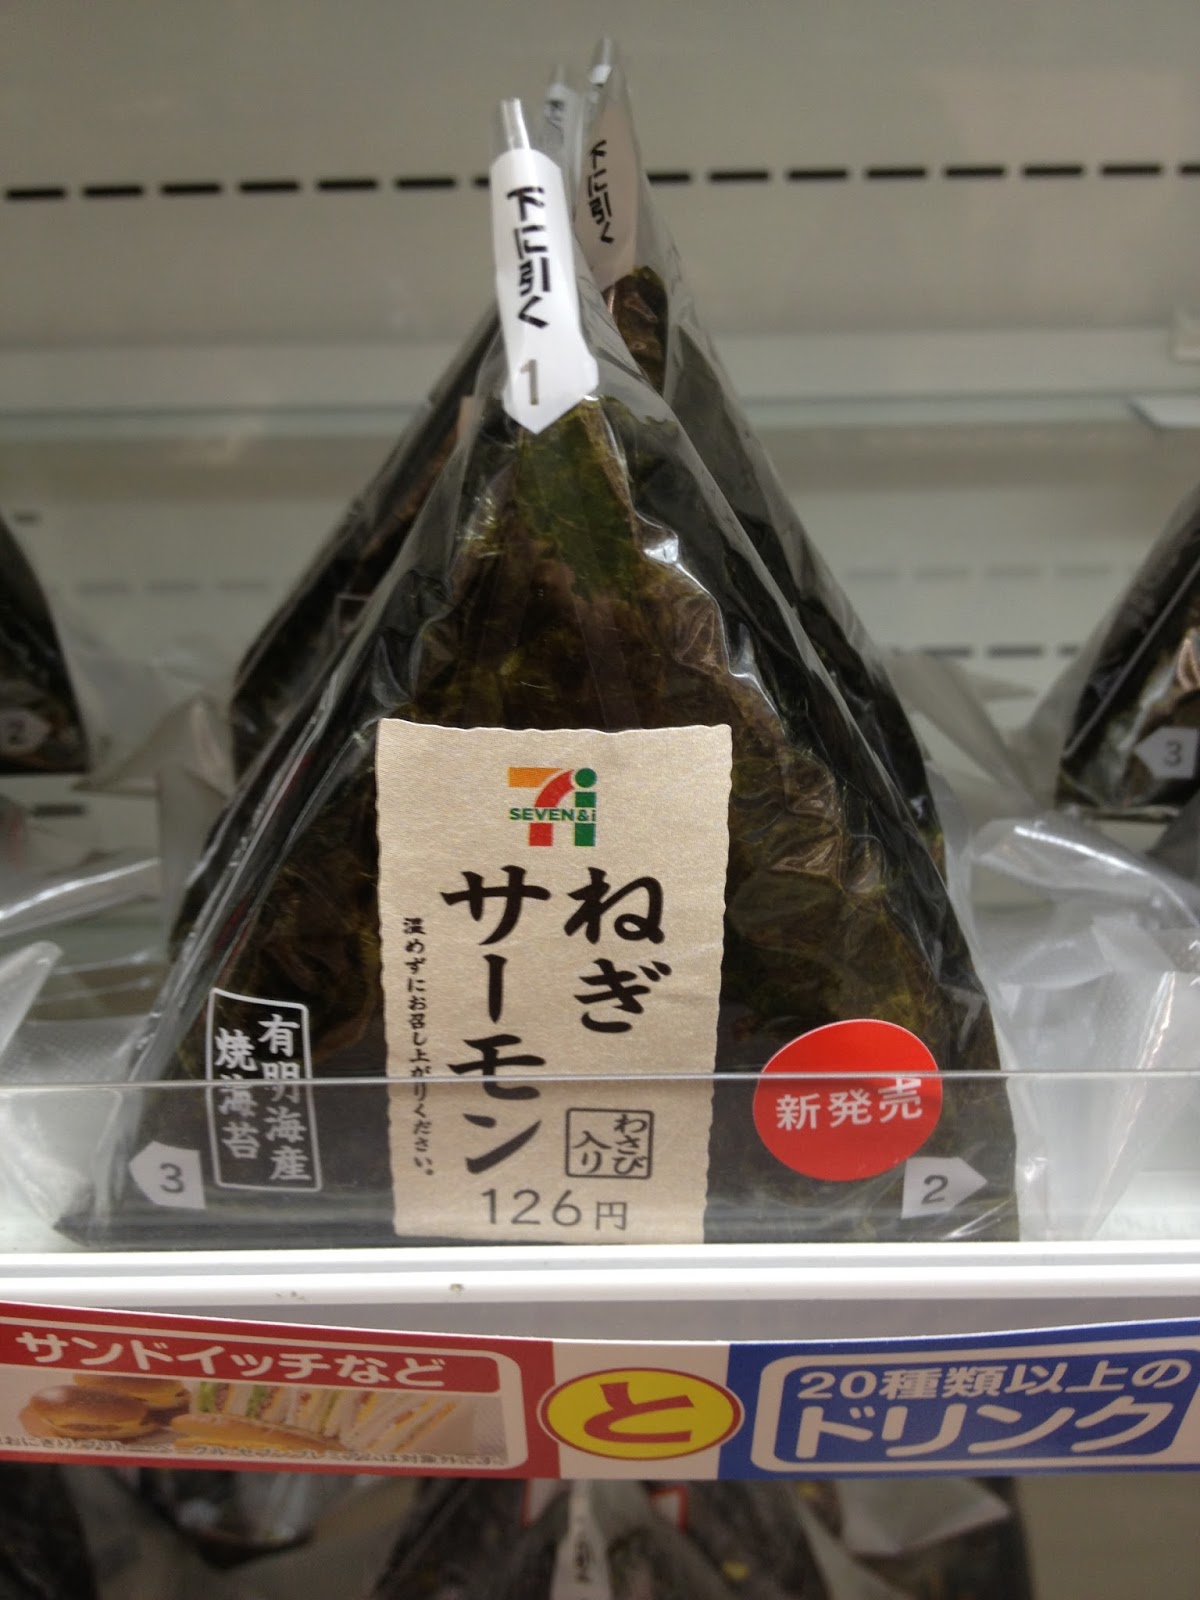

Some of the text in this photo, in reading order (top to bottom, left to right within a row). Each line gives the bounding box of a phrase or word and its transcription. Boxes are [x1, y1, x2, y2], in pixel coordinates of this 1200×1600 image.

[507, 186, 551, 330] 下に引く
[519, 359, 540, 406] 1
[563, 866, 672, 1034] ねぎ
[439, 864, 552, 1175] サーモン
[213, 1026, 261, 1161] 焼海苔
[258, 1013, 312, 1182] 有明海産
[775, 1075, 924, 1131] 新発売
[572, 1130, 613, 1174] 入り
[612, 1113, 649, 1176] わさび
[159, 1162, 185, 1194] 3
[920, 1174, 949, 1206] 2
[480, 1187, 629, 1231] 126円
[15, 1330, 447, 1388] サンドイッチなど
[797, 1357, 1192, 1401] 20種類以上の
[582, 1380, 696, 1444] と
[794, 1394, 1174, 1459] ドリンク
